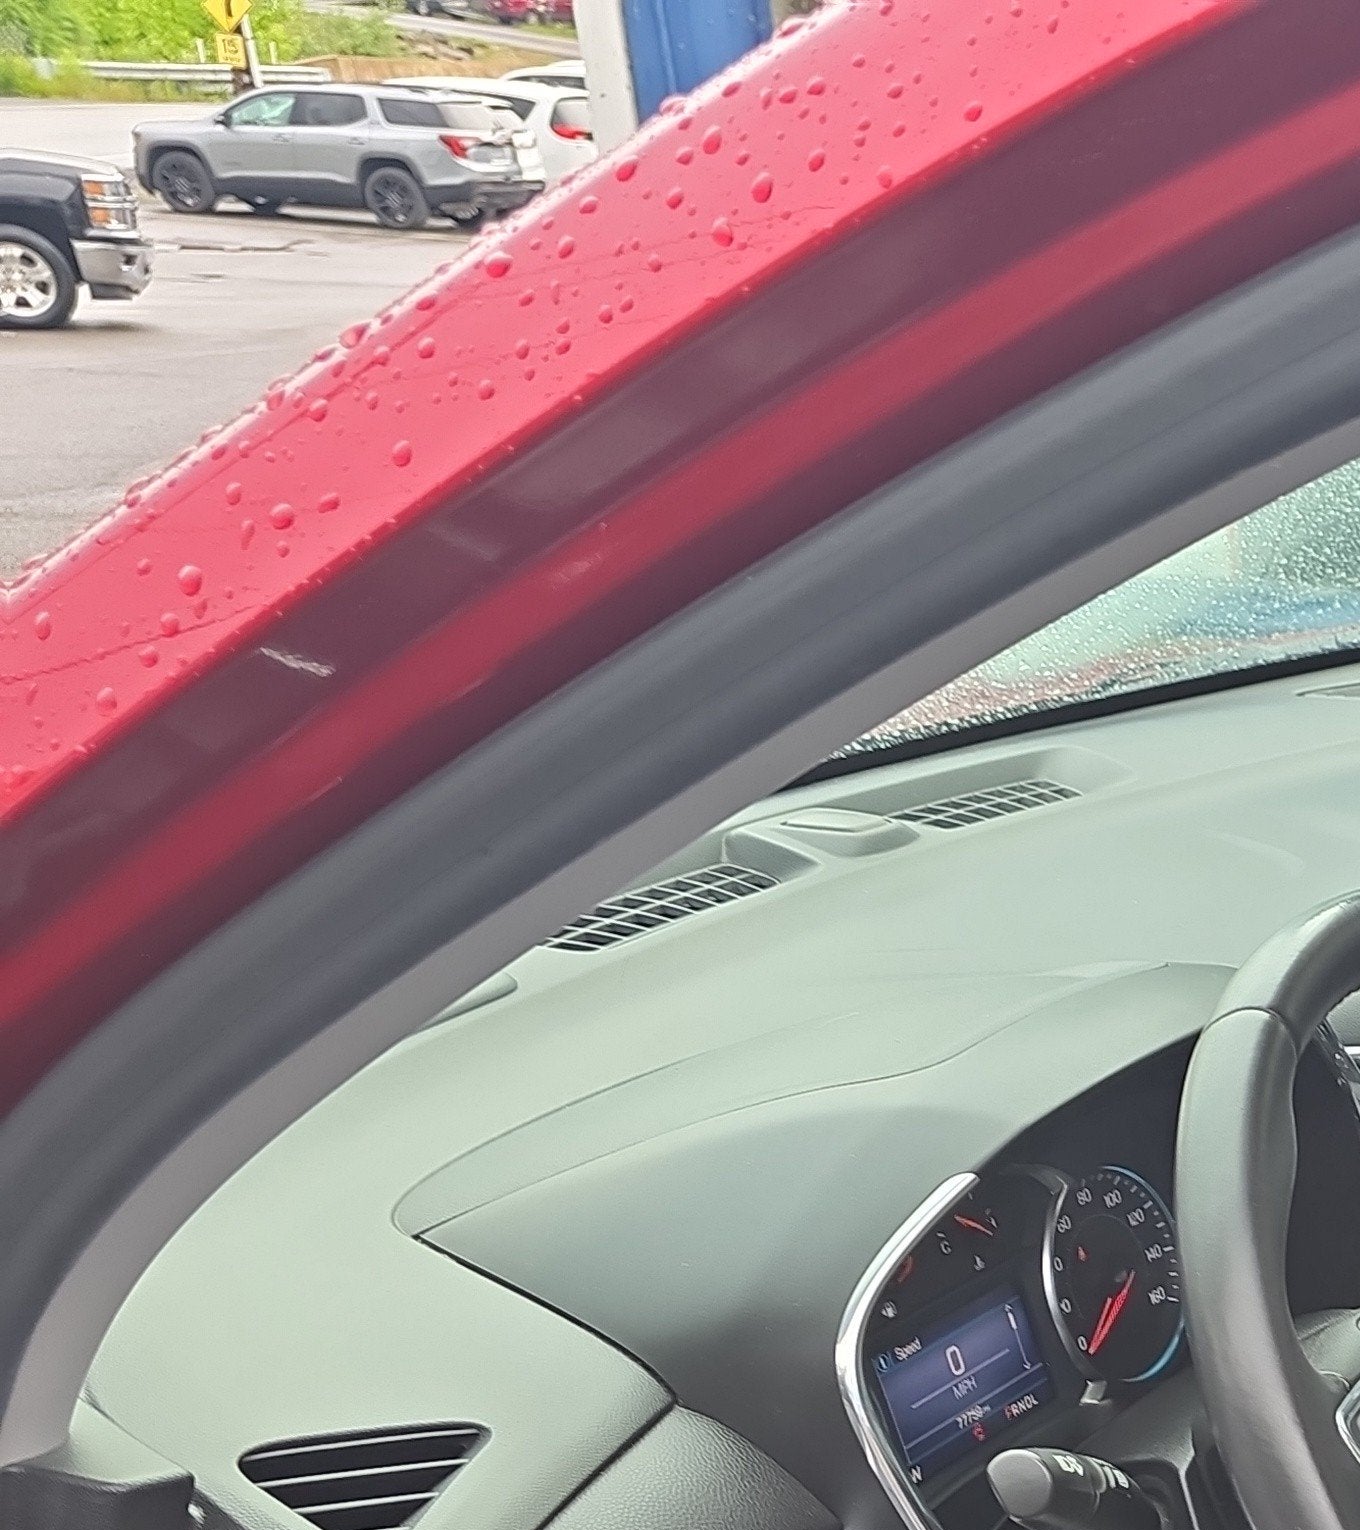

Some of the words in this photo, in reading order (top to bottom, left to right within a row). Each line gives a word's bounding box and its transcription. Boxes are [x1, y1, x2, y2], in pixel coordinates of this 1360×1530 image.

[1076, 1187, 1092, 1206] 80
[1103, 1189, 1122, 1208] 100
[1057, 1214, 1072, 1233] 60
[893, 1336, 922, 1361] Speed
[945, 1344, 966, 1376] 0
